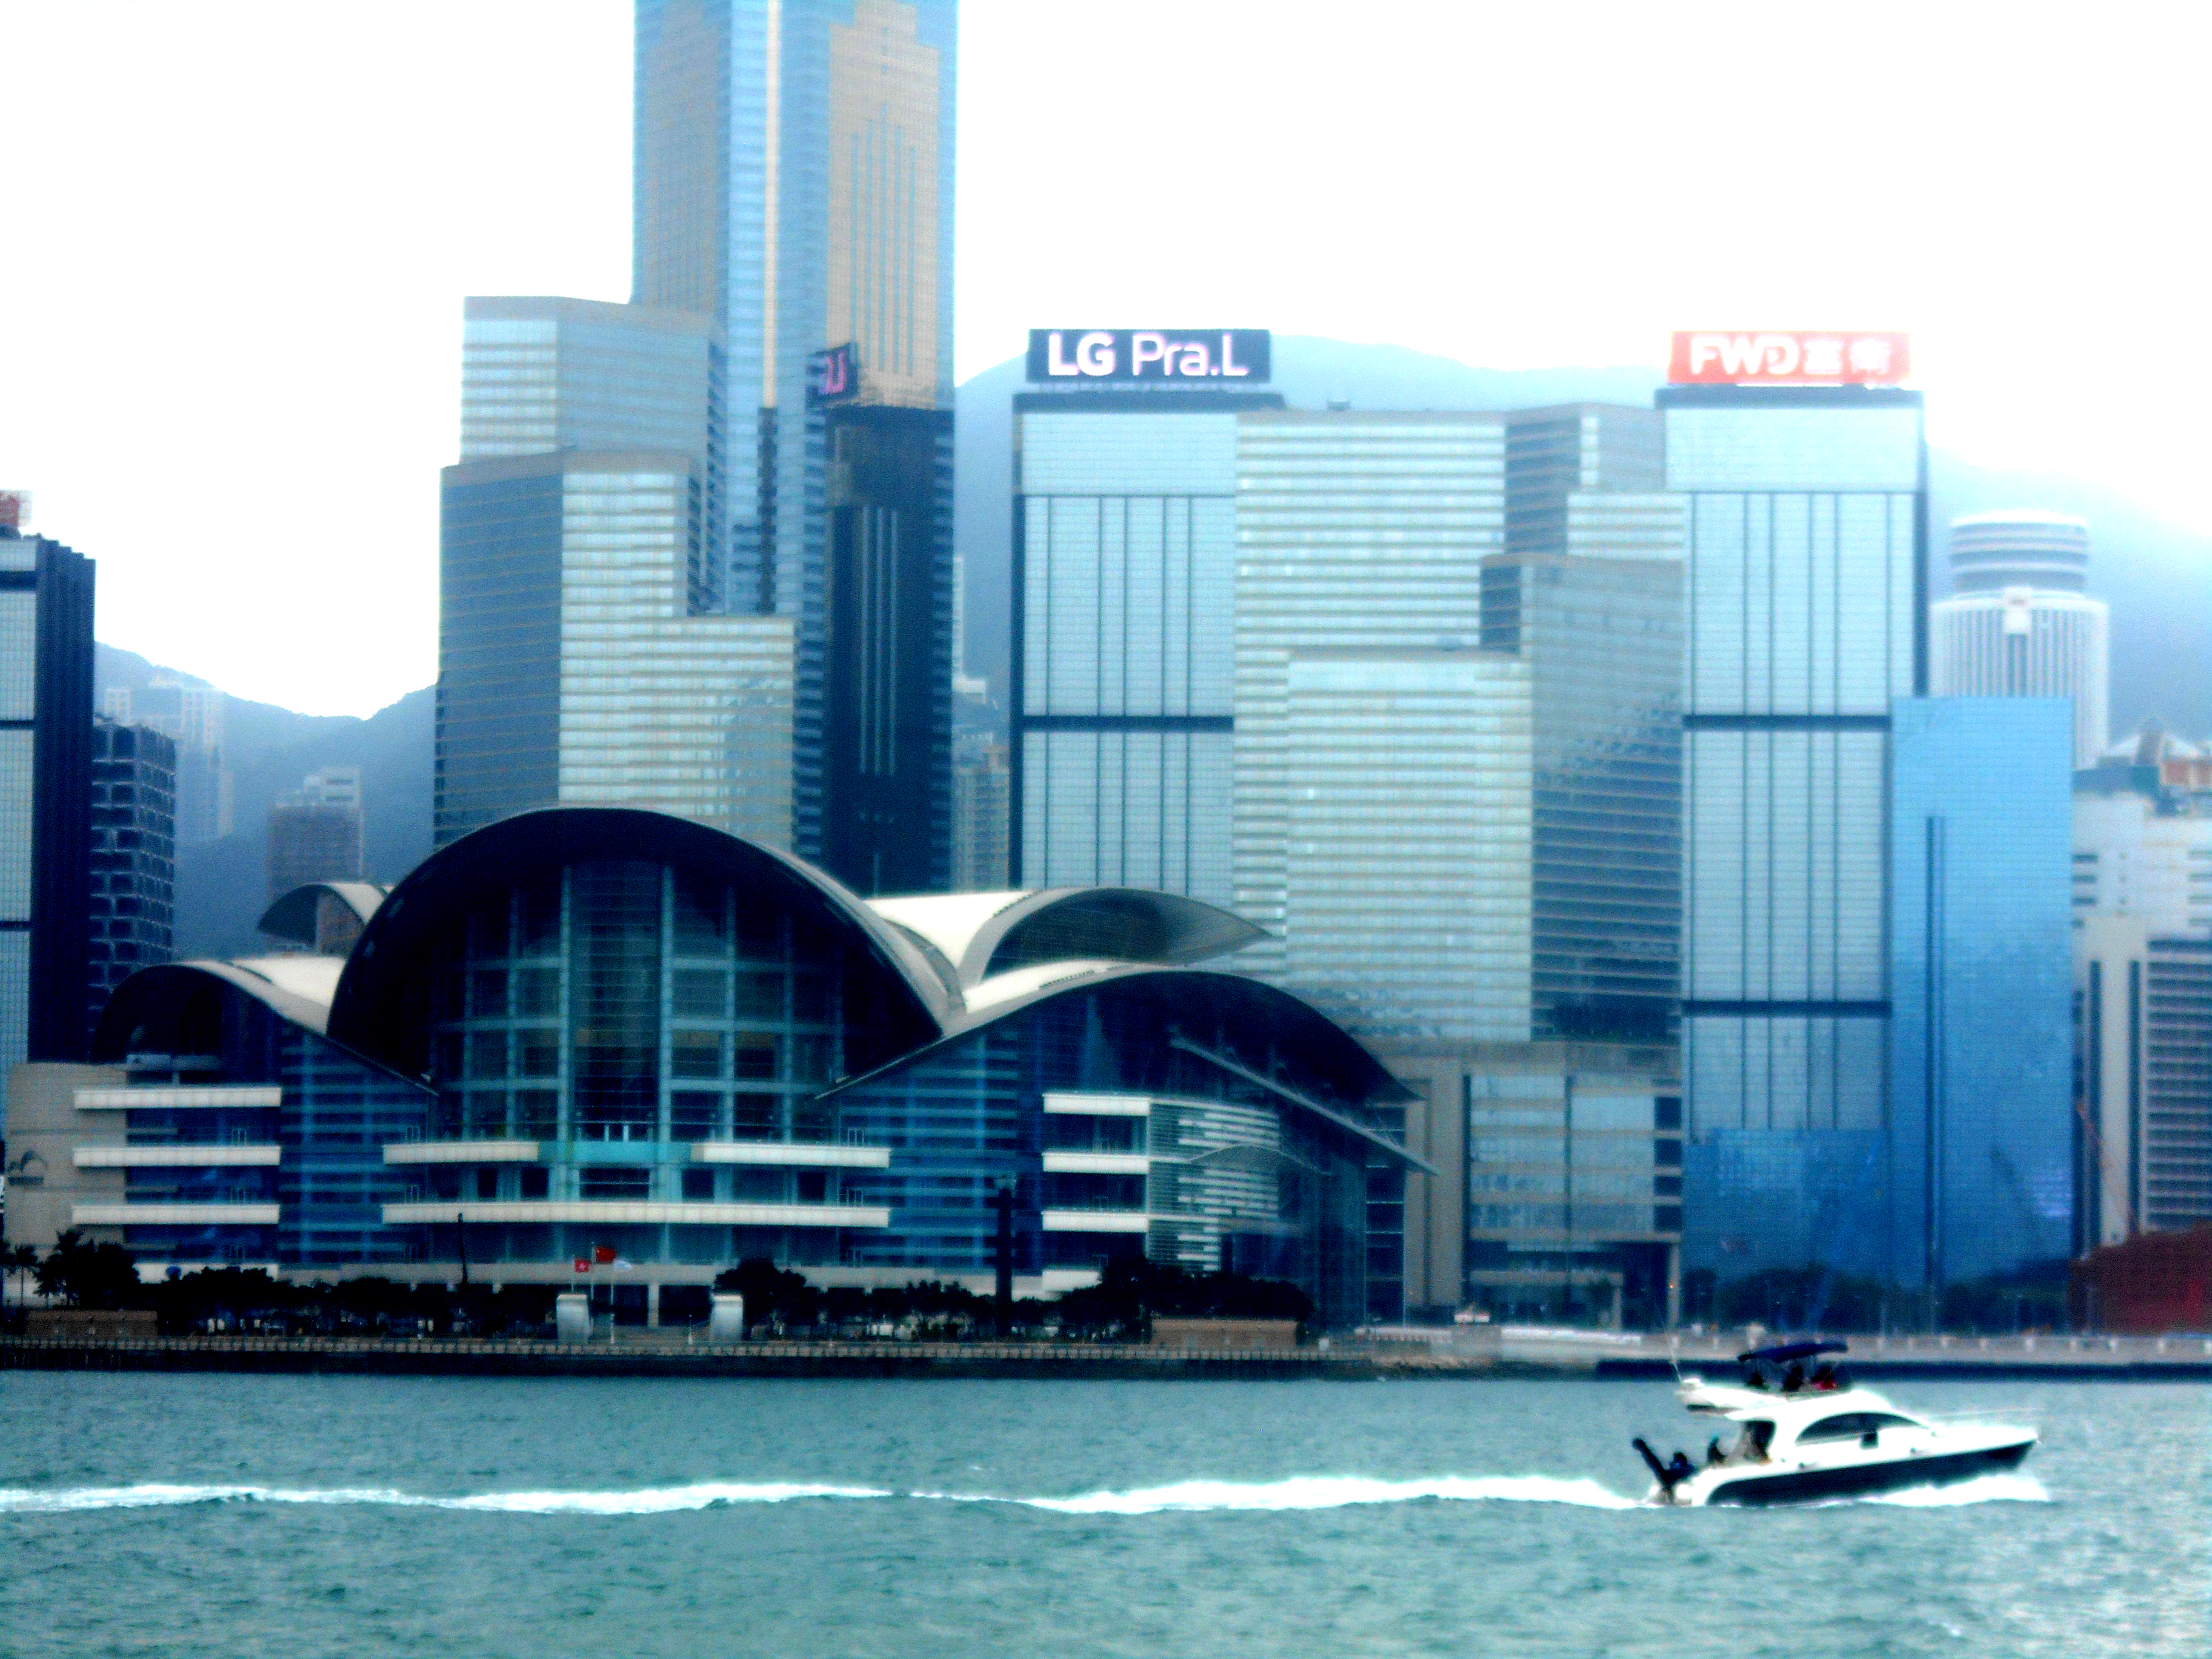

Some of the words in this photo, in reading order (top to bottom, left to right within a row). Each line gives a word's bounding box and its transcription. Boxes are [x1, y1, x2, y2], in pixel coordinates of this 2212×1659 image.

[1048, 332, 1116, 376] LG
[1132, 333, 1249, 376] Pra.L
[1691, 334, 1799, 375] FWD
